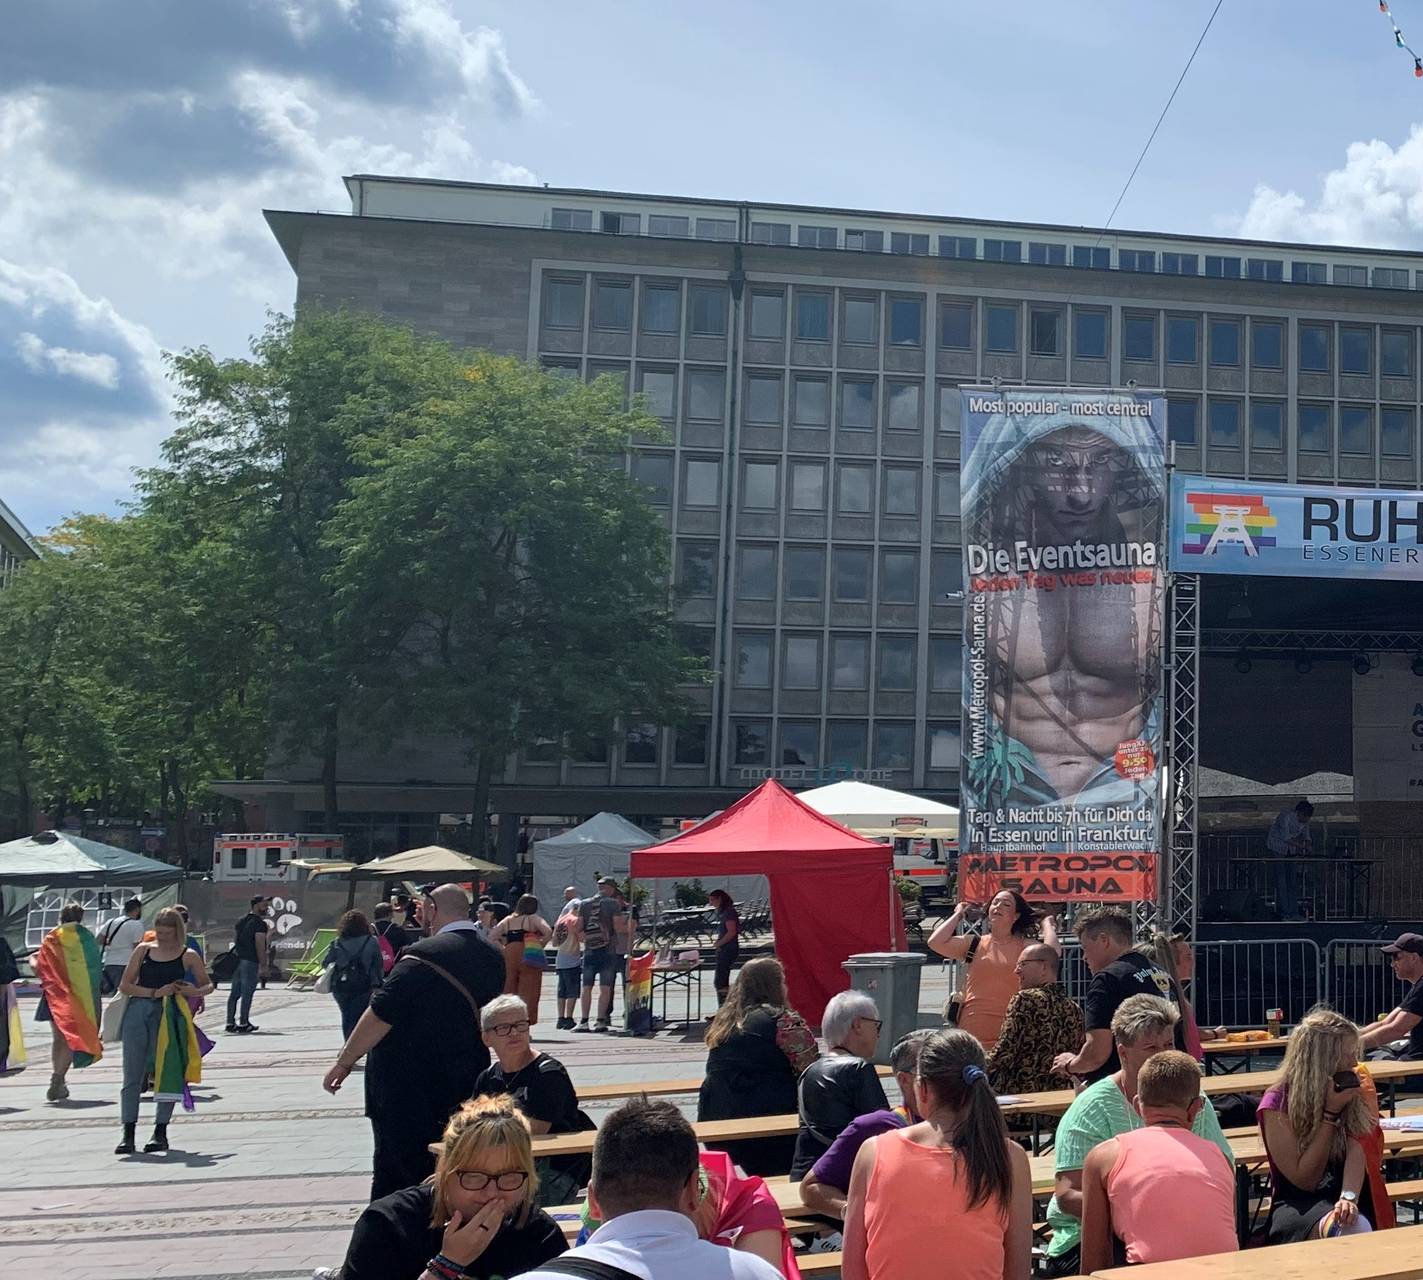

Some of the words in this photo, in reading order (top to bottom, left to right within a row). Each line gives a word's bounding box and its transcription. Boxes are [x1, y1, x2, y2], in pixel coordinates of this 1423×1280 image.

[969, 397, 1002, 413] Most
[1006, 399, 1058, 417] popular
[1071, 402, 1104, 415] most
[1106, 401, 1152, 416] central
[968, 544, 1010, 575] Die
[1014, 540, 1156, 571] Eventsauna
[1303, 544, 1419, 563] ESSENER
[1061, 572, 1097, 586] was
[969, 593, 987, 758] www.Metropol-Sauna.de
[968, 808, 992, 826] Tag
[996, 809, 1005, 823] &
[1009, 809, 1044, 823] Nacht
[1047, 808, 1063, 821] bis
[1066, 809, 1081, 825] 7h
[1084, 808, 1103, 822] für
[1107, 807, 1135, 822] Dich
[972, 828, 984, 843] In
[988, 828, 1031, 842] Essen
[1034, 827, 1058, 842] und
[1062, 828, 1074, 842] in
[1078, 825, 1153, 842] Frankfurt
[970, 855, 1152, 872] METROPOL
[1000, 877, 1124, 895] SAUNA
